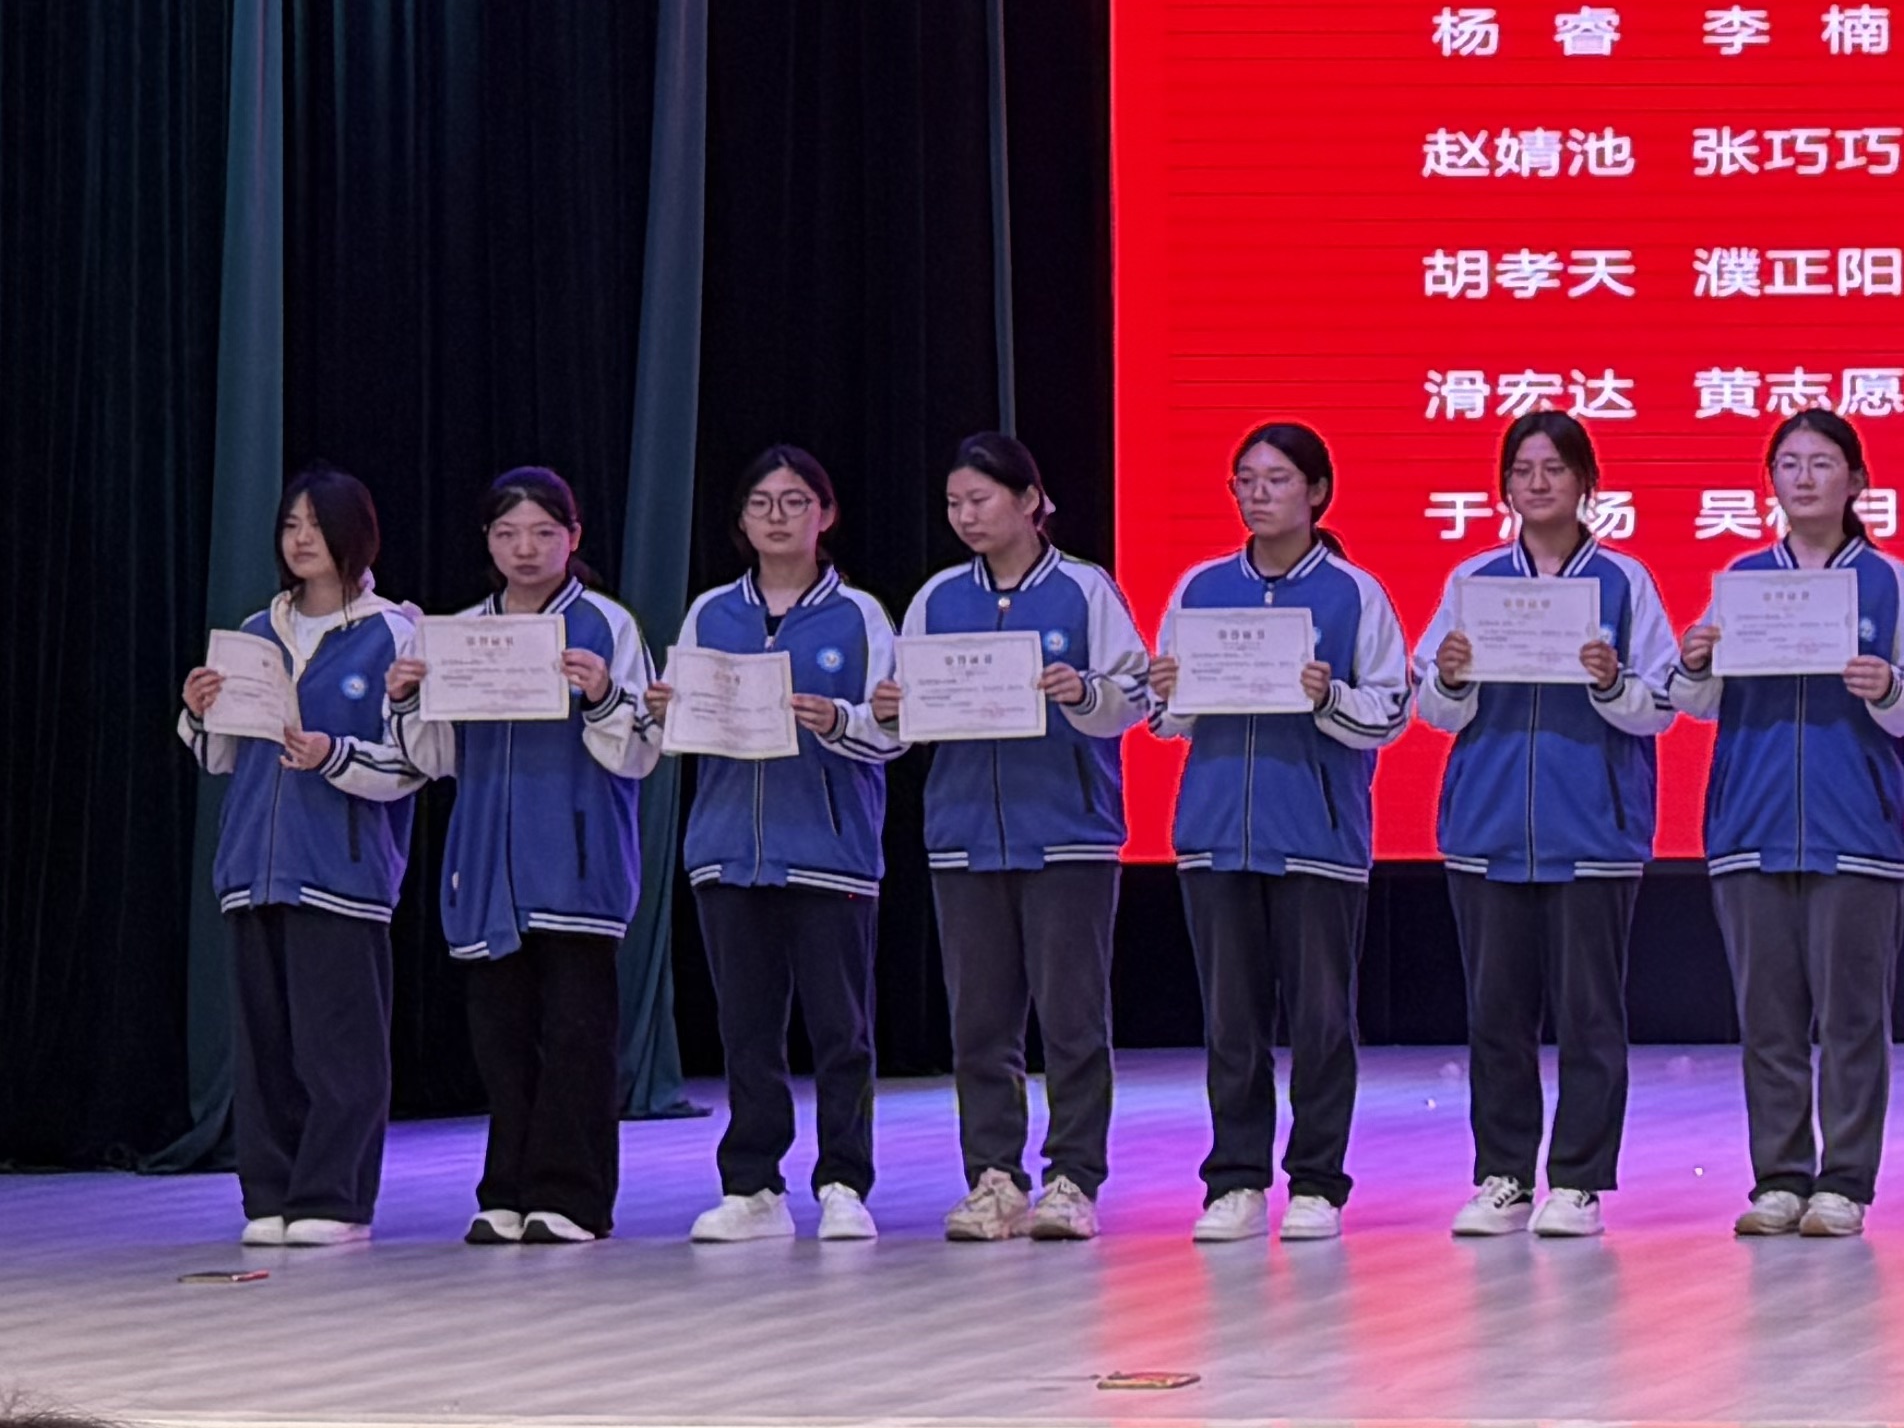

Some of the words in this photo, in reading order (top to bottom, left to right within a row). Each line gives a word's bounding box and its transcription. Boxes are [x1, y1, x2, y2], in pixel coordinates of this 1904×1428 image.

[1423, 128, 1634, 176] 赵婧池
[1694, 127, 1902, 175] 张巧巧
[1423, 249, 1634, 298] 胡孝天
[1694, 248, 1901, 297] 濮正阳
[1424, 369, 1637, 419] 滑宏达
[1694, 367, 1904, 418] 黄志愿
